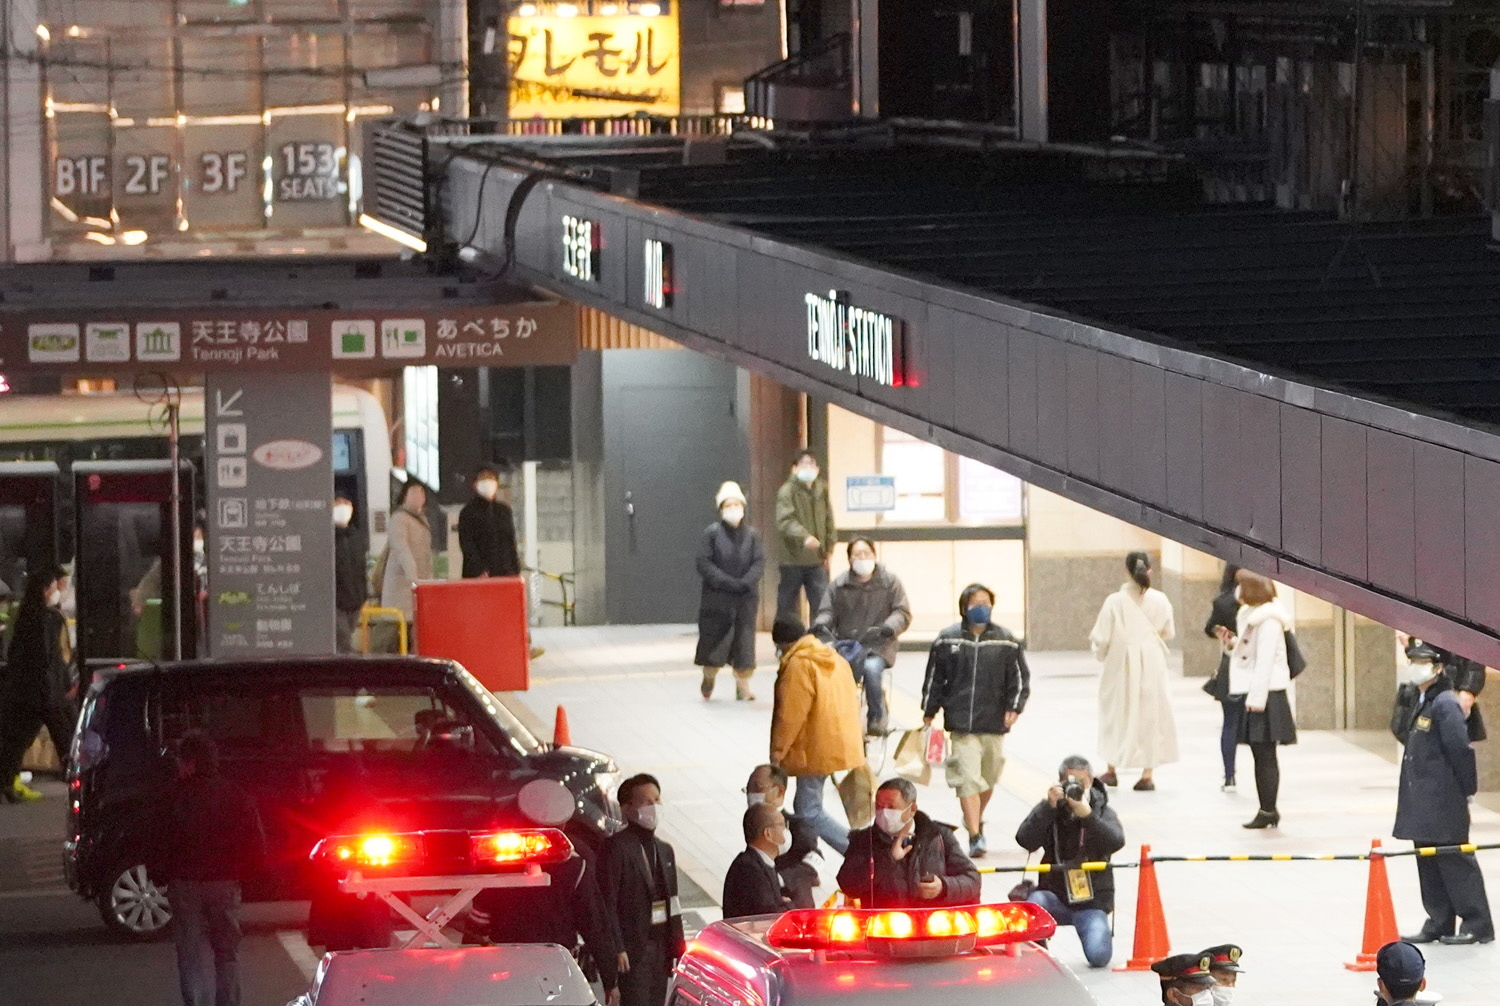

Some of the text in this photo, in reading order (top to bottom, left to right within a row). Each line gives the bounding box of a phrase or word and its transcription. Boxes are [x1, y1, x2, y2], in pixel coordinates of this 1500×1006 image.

[283, 144, 334, 176] 153
[57, 153, 246, 195] B1F 2F 3F
[280, 177, 338, 200] SEATS
[192, 319, 308, 343] 天王寺公園
[437, 316, 538, 340] あべちか
[192, 346, 279, 364] Tennoji Park
[435, 341, 503, 358] AVETICA
[848, 305, 894, 387] STATION
